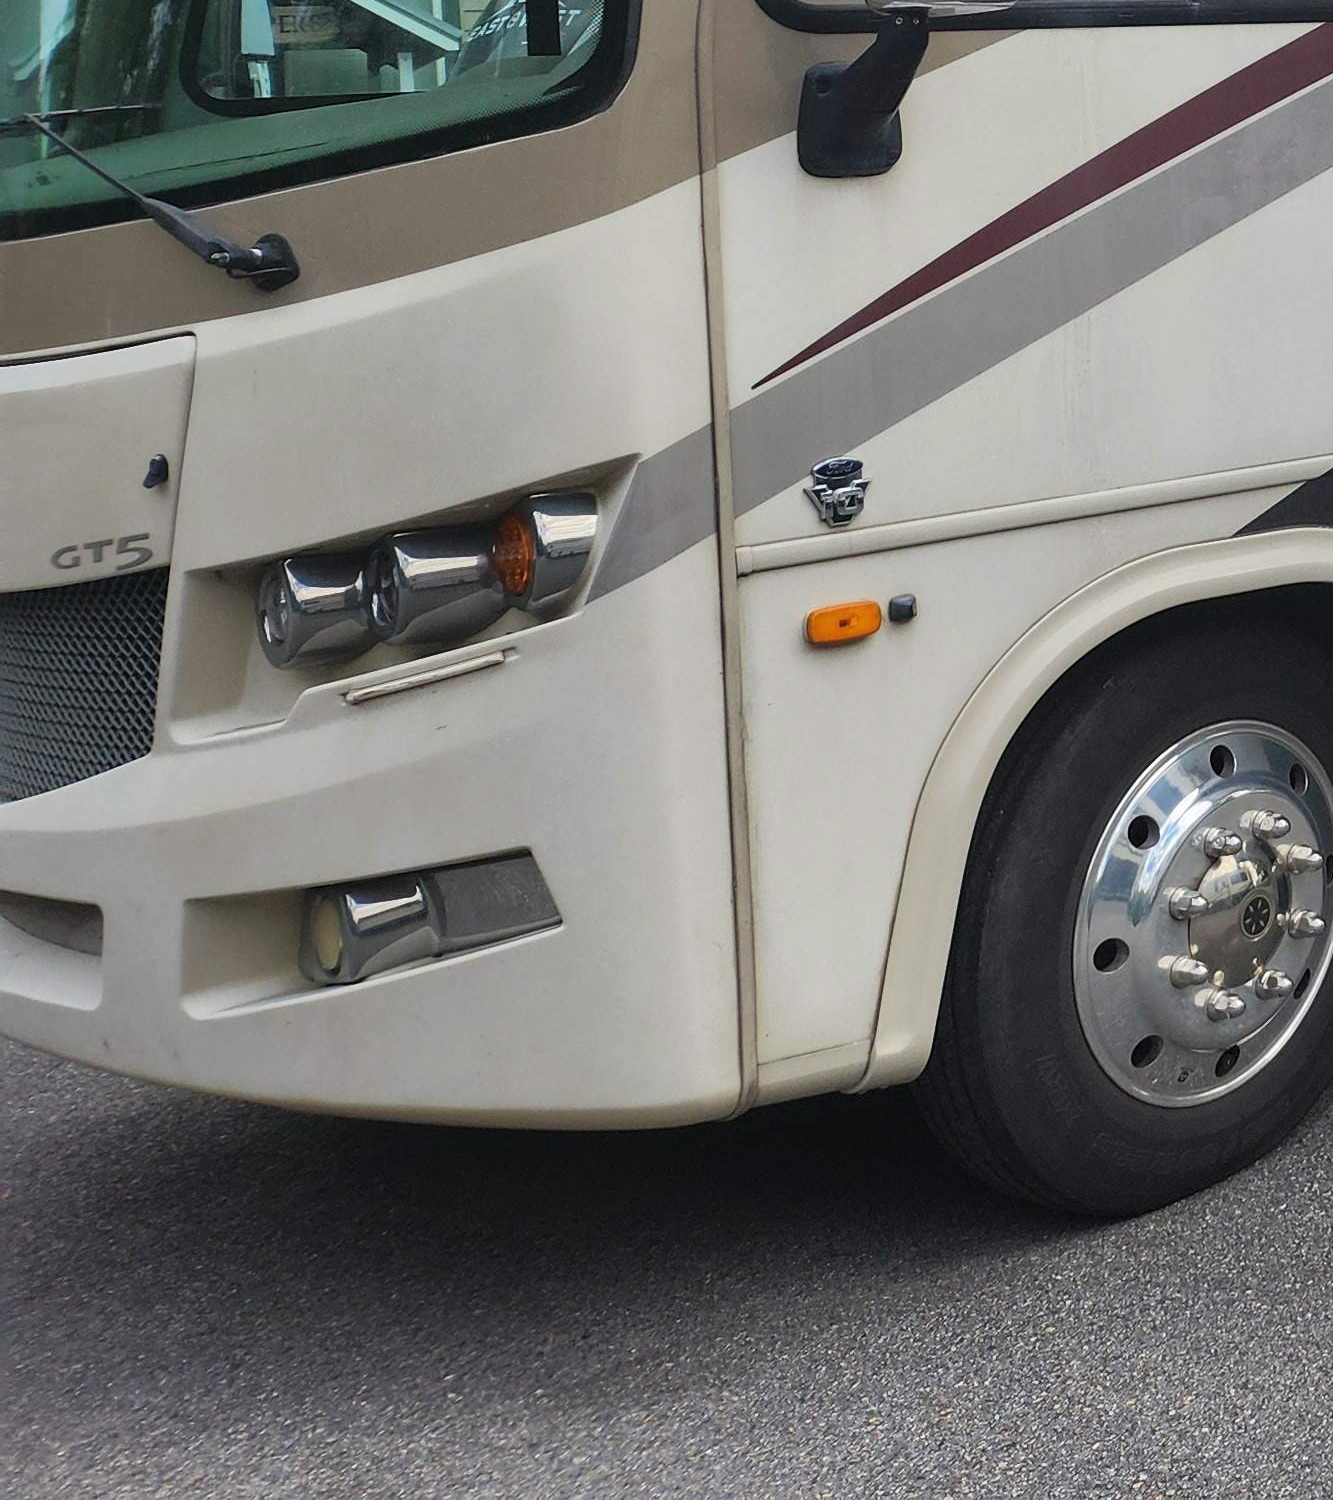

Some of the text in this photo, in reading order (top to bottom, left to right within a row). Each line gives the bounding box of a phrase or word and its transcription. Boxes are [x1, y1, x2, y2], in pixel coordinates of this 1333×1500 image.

[467, 15, 510, 43] EAST
[826, 461, 853, 475] Ford
[49, 532, 154, 571] GT5
